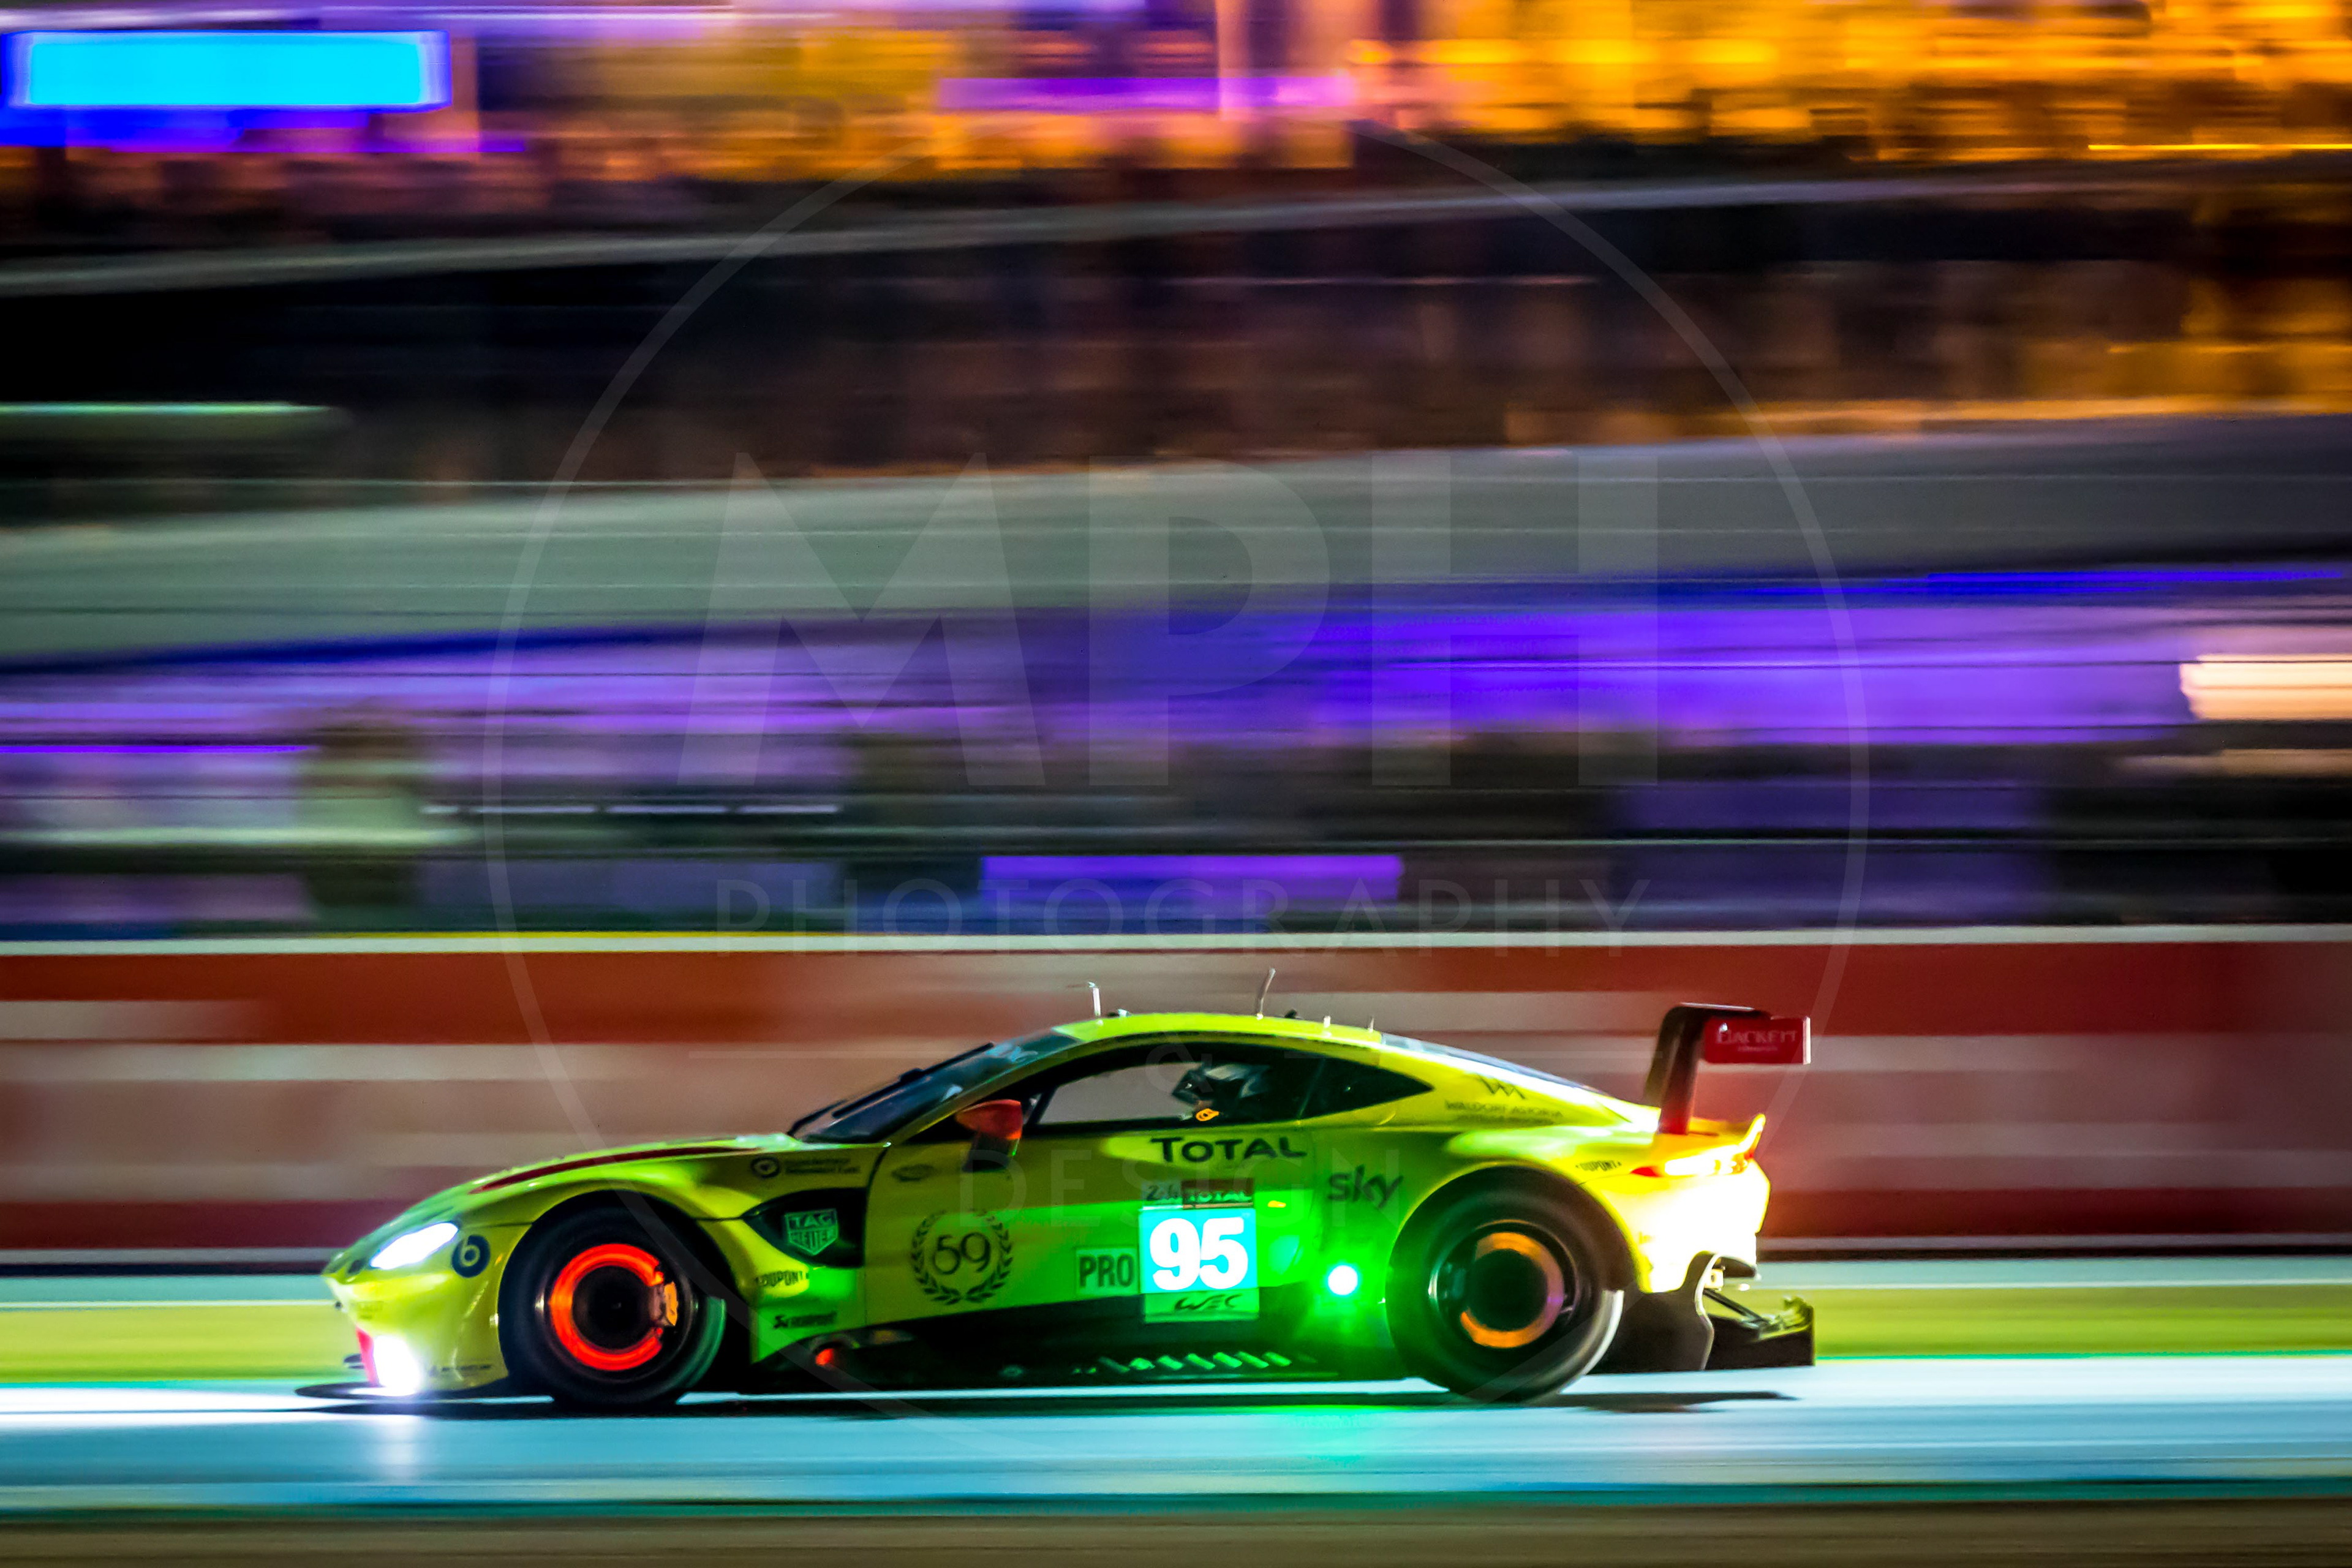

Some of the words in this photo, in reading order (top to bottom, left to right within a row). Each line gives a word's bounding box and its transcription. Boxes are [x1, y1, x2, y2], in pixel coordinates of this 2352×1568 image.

[1150, 1136, 1308, 1163] TOTAL
[1328, 1164, 1403, 1210] sky
[789, 1212, 834, 1227] TAG
[933, 1232, 991, 1275] 59
[1079, 1253, 1133, 1287] PRO
[1150, 1218, 1248, 1291] 95
[1175, 1294, 1243, 1310] WEC
